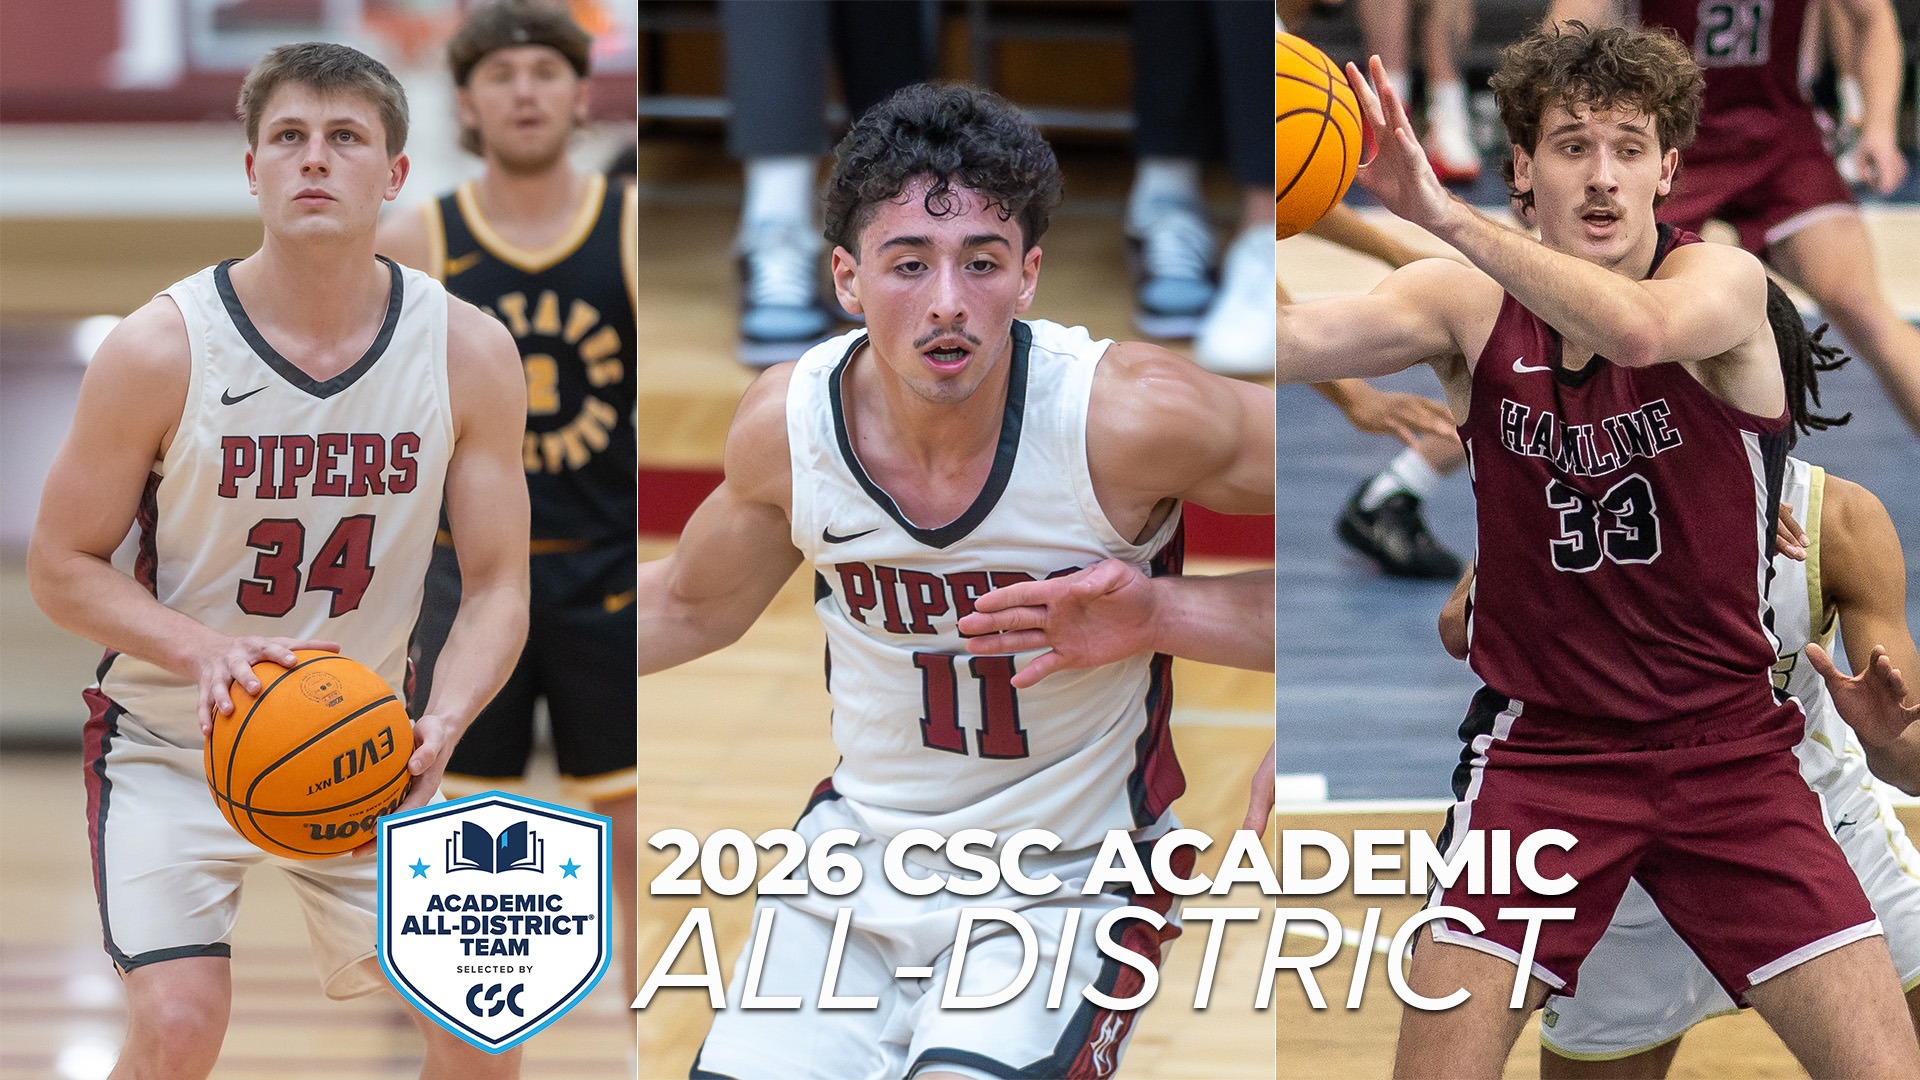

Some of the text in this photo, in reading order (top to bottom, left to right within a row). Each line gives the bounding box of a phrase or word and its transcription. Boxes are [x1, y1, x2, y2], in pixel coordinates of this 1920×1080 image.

[1701, 1, 1765, 61] 21
[483, 290, 624, 388] TAVUS
[217, 431, 421, 499] PIPERS
[1501, 398, 1683, 477] HAMLINE
[1545, 473, 1662, 573] 33
[236, 514, 376, 618] 34
[834, 561, 1083, 638] PIPE
[912, 651, 1029, 759] 11
[306, 725, 394, 796] EVO NXT
